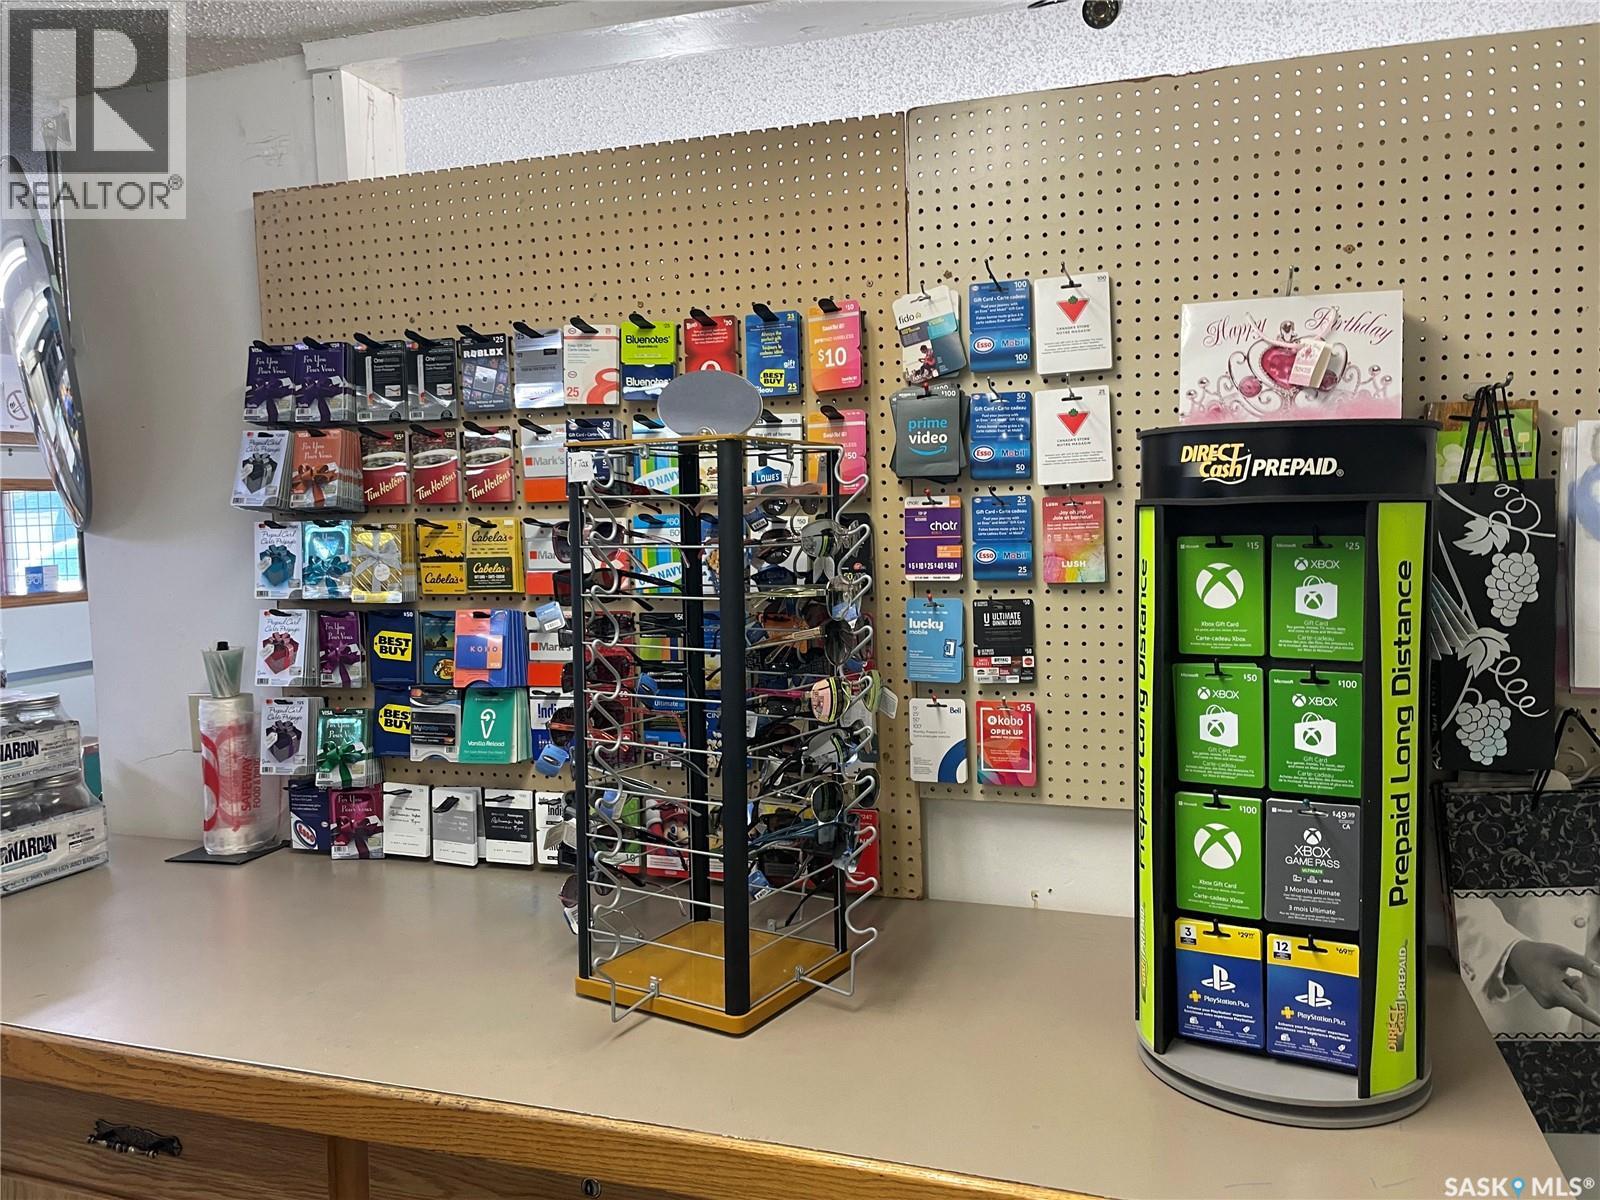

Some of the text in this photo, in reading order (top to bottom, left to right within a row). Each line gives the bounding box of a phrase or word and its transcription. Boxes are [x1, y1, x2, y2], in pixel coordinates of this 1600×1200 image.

[1202, 306, 1393, 347] Happy Birthday
[626, 335, 668, 344] Bluenotes
[1002, 338, 1024, 348] Mobil
[463, 348, 504, 358] ROBLOX
[818, 346, 847, 368] $10
[567, 387, 579, 397] 25
[908, 417, 948, 432] prime
[909, 430, 948, 444] video
[1002, 449, 1025, 458] Mobil
[1180, 442, 1244, 463] DIRECT
[533, 456, 564, 466] Mark's
[1016, 464, 1026, 472] 50
[1199, 460, 1242, 478] Cash
[656, 471, 679, 485] NAVY
[756, 473, 780, 482] LOWE'S
[364, 475, 405, 502] Tim Hortons
[416, 472, 456, 500] Tim Hortons
[468, 471, 510, 500] Tim Hortons
[930, 520, 958, 530] chatr
[472, 530, 507, 542] Cabela's
[1247, 542, 1259, 550] $15
[1345, 542, 1360, 550] $25
[1004, 551, 1027, 559] Mobil
[473, 562, 506, 574] Cabela's
[1062, 560, 1086, 568] LUSH
[1310, 560, 1340, 569] XBOX
[658, 566, 681, 578] NAVY
[424, 572, 459, 585] Cabela's
[992, 612, 1021, 620] ULTIMATE
[909, 618, 944, 631] lucky
[378, 636, 411, 647] BEST
[380, 646, 408, 656] BUY
[1244, 674, 1257, 682] $50
[1338, 680, 1357, 688] $100
[1212, 690, 1239, 699] XBOX
[1309, 697, 1338, 706] XBOX
[1017, 704, 1031, 712] $25
[997, 716, 1023, 726] kobo
[1389, 560, 1414, 907] Prepaid Long Distance
[241, 757, 252, 811] SAFEWAY
[253, 786, 261, 808] FOOD
[1240, 806, 1257, 814] $100
[1294, 845, 1331, 858] XBOX
[1285, 856, 1340, 868] GAME PASS
[1290, 886, 1312, 894] Months
[1309, 907, 1336, 915] Ultimate
[1185, 927, 1192, 936] 3
[1277, 942, 1288, 951] 12
[1399, 946, 1407, 999] PREPAID
[1388, 1006, 1398, 1052] DIRECT
